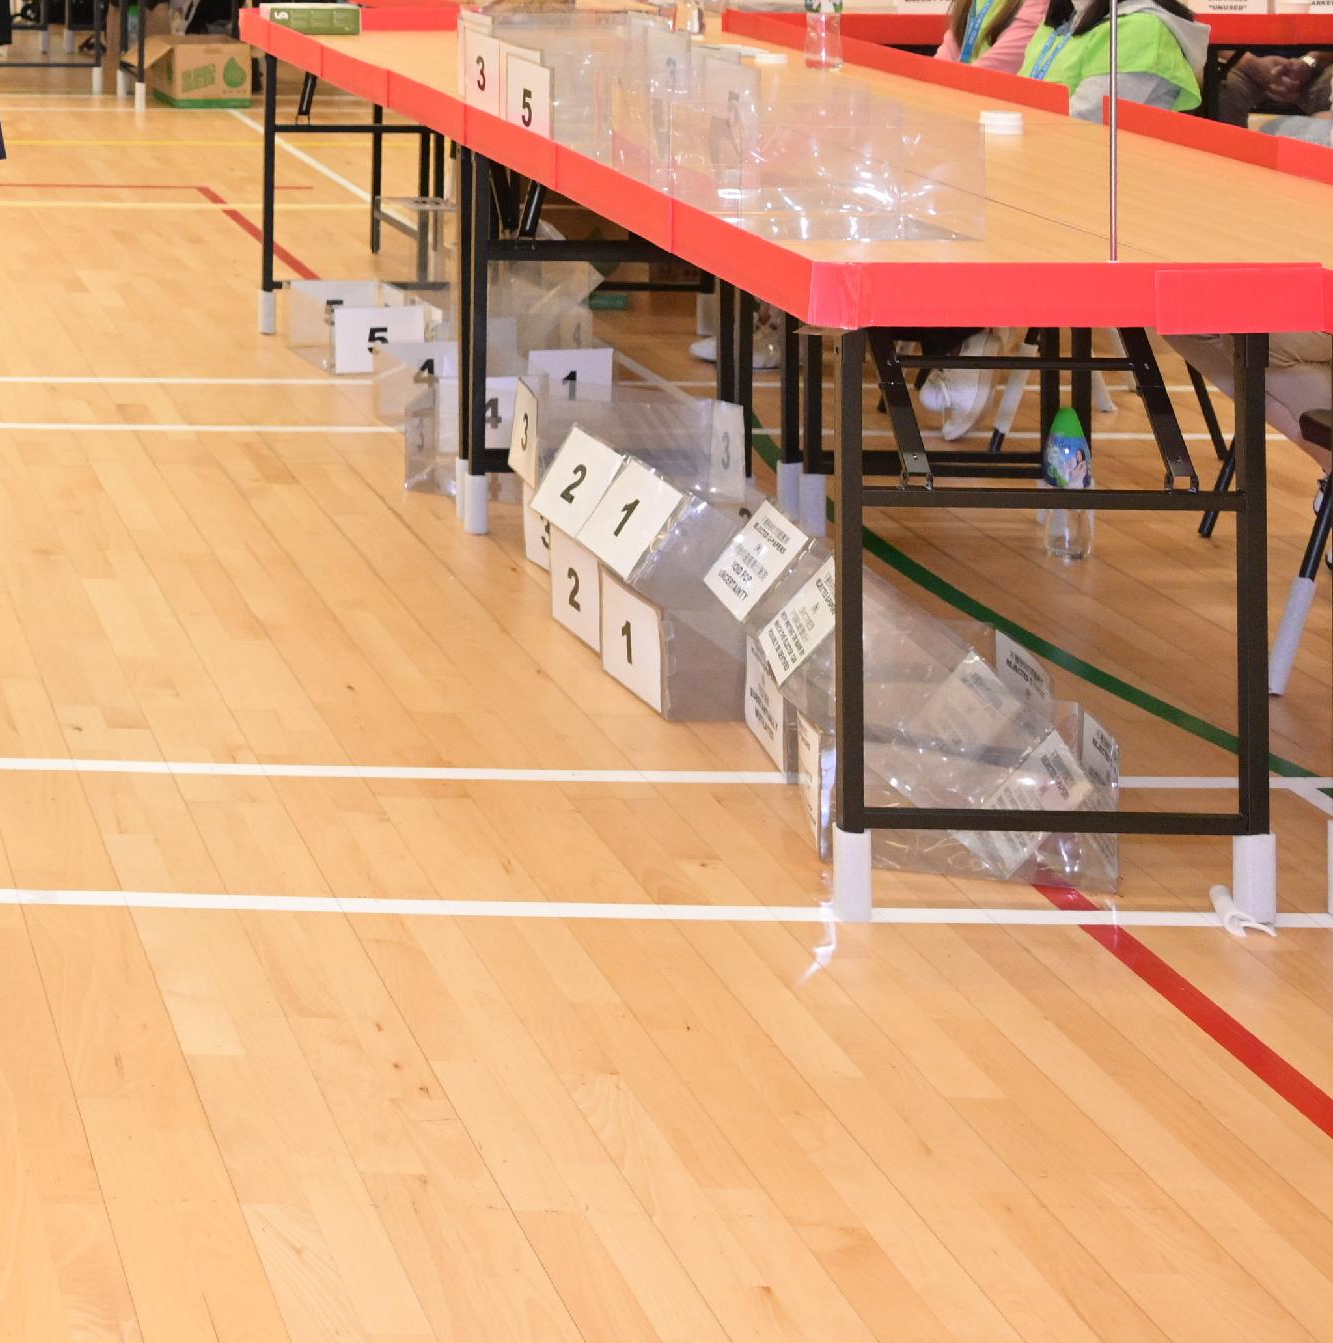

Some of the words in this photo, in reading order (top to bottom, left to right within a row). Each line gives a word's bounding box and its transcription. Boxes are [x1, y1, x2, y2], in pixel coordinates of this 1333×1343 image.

[476, 56, 486, 92] 3
[521, 88, 533, 128] 5
[562, 369, 578, 401] 1
[520, 412, 530, 452] 3
[559, 463, 588, 504] 2
[613, 498, 641, 538] 1
[566, 567, 581, 612] 2
[621, 620, 633, 665] 1
